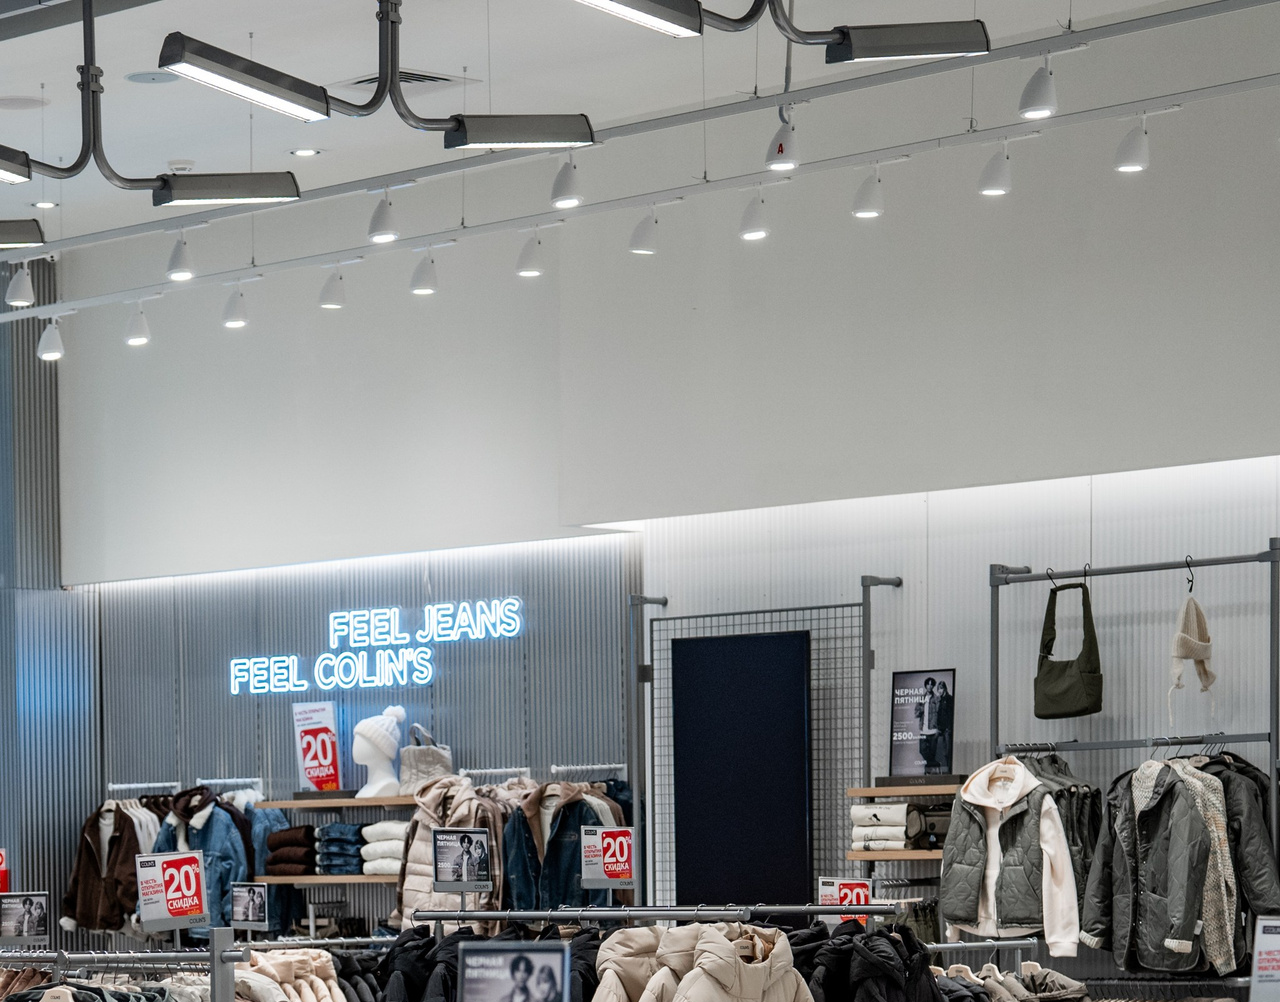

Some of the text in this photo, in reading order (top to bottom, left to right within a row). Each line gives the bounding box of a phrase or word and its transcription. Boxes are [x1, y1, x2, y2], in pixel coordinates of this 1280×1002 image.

[329, 598, 521, 649] FEEL JEANS
[230, 647, 433, 694] FEEL COLIN'S
[895, 688, 924, 696] ЧЕРНАЯ
[894, 695, 930, 704] ПЯТНИЦА
[893, 732, 913, 740] 2500
[305, 765, 335, 778] СКИДКА
[603, 836, 632, 863] 20%
[604, 863, 630, 872] СКИДКА
[164, 863, 200, 900] 20%
[167, 896, 199, 909] СКИДКА
